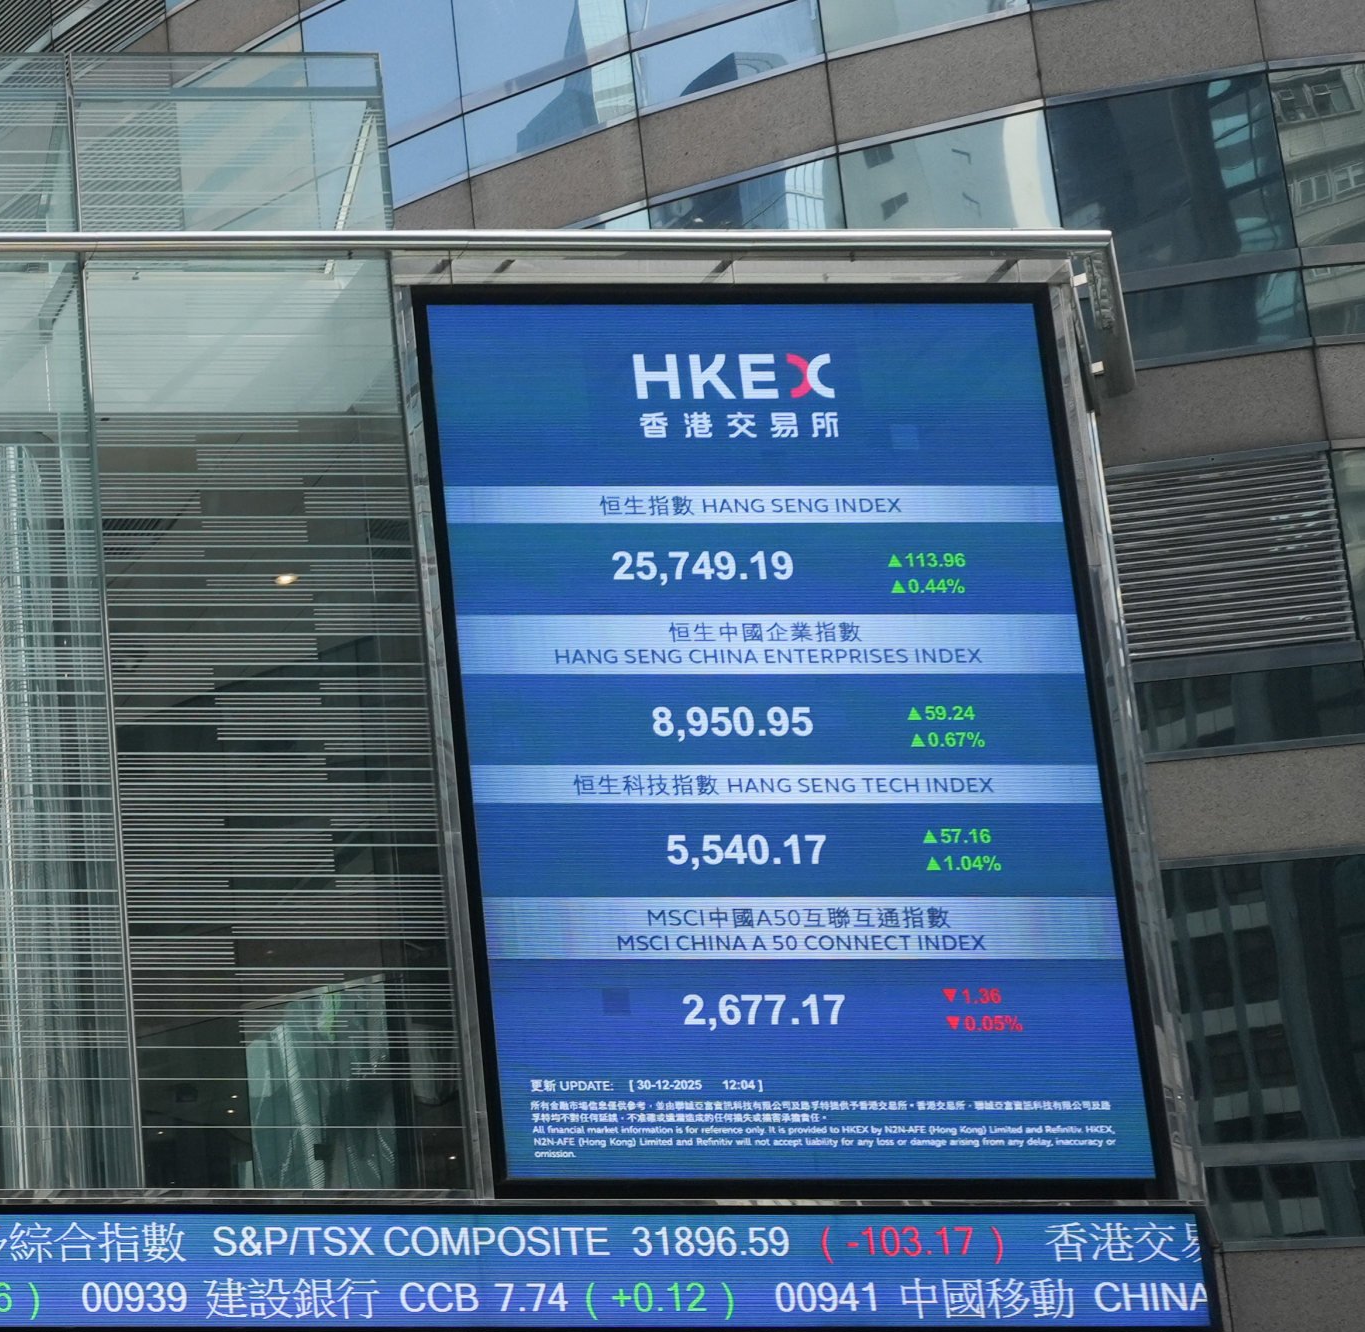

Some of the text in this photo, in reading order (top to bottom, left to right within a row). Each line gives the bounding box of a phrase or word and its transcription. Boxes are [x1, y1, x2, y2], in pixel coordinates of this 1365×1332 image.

[633, 354, 835, 399] HKEX
[640, 412, 838, 438] 香港交易所
[600, 496, 901, 515] 恒生指數 HANG SENG INDEX
[613, 551, 793, 585] 25,749.19
[904, 553, 967, 568] 113.96
[908, 579, 965, 592] 0.44%
[669, 622, 862, 642] 恒生中國企業指數
[555, 648, 982, 664] HANG SENG CHINA ENTERPRISES INDEX
[926, 706, 975, 720] 59.24
[653, 707, 813, 741] 8,950.95
[928, 732, 985, 747] 0.67%
[573, 774, 994, 796] 恒生科技指數 HANG SENG TECH INDEX
[942, 828, 991, 843] 57.16
[668, 835, 826, 870] 5,540.17
[944, 855, 1002, 871] 1.04%
[648, 906, 951, 928] MSCI中國A50互聯互通指數
[617, 935, 989, 950] MSCI CHINA A 50 CONNECT INDEX
[963, 988, 1001, 1004] 1.36
[683, 994, 845, 1031] 2,677.17
[964, 1016, 1023, 1031] 0.05%
[531, 1080, 556, 1091] 更新
[560, 1081, 613, 1091] UPDATE:
[214, 1226, 374, 1256] S&P/TSX
[384, 1227, 610, 1256] COMPOSITE
[632, 1227, 789, 1256] 31896.59
[82, 1282, 187, 1312] 00939
[204, 1278, 379, 1319] 建設銀行
[400, 1282, 478, 1312] CCB
[495, 1283, 568, 1311] 7.74
[776, 1282, 876, 1312] 00941
[901, 1278, 1074, 1319] 中國移動
[1095, 1282, 1208, 1313] CHINA
